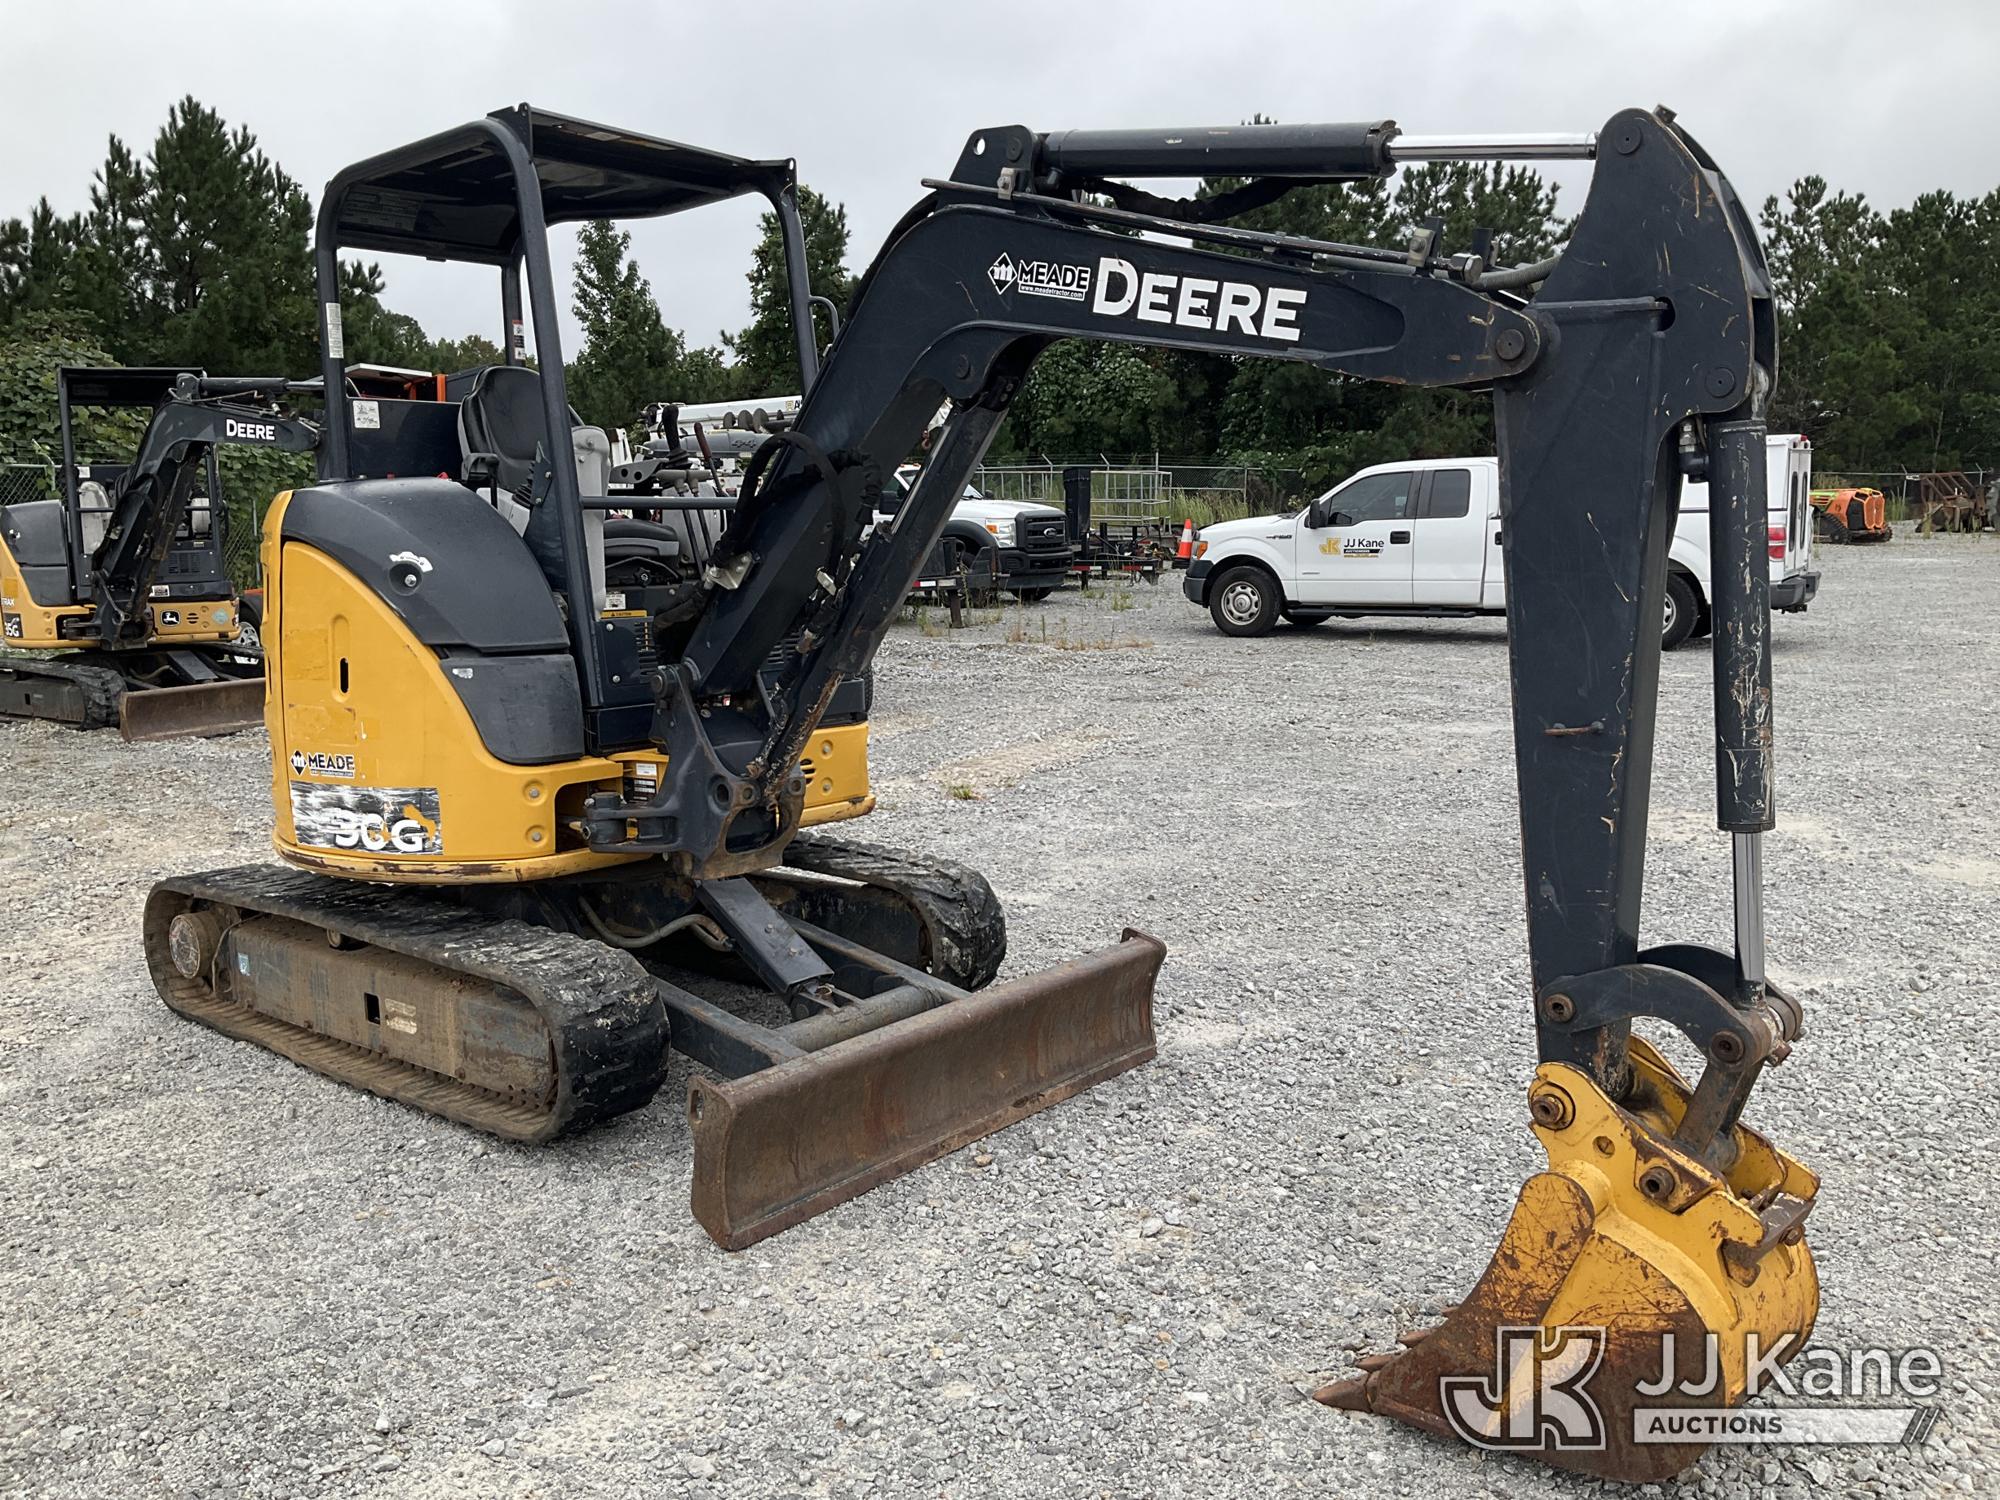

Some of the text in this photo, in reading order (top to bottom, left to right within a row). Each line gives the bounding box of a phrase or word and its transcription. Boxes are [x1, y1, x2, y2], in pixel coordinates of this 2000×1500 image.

[1019, 260, 1090, 290] MEADE
[1020, 285, 1083, 298] www.meadetractor.com
[1093, 257, 1307, 342] DEERE
[226, 418, 275, 441] DEERE
[1344, 538, 1385, 548] JJ Kane
[307, 753, 355, 770] MEADE
